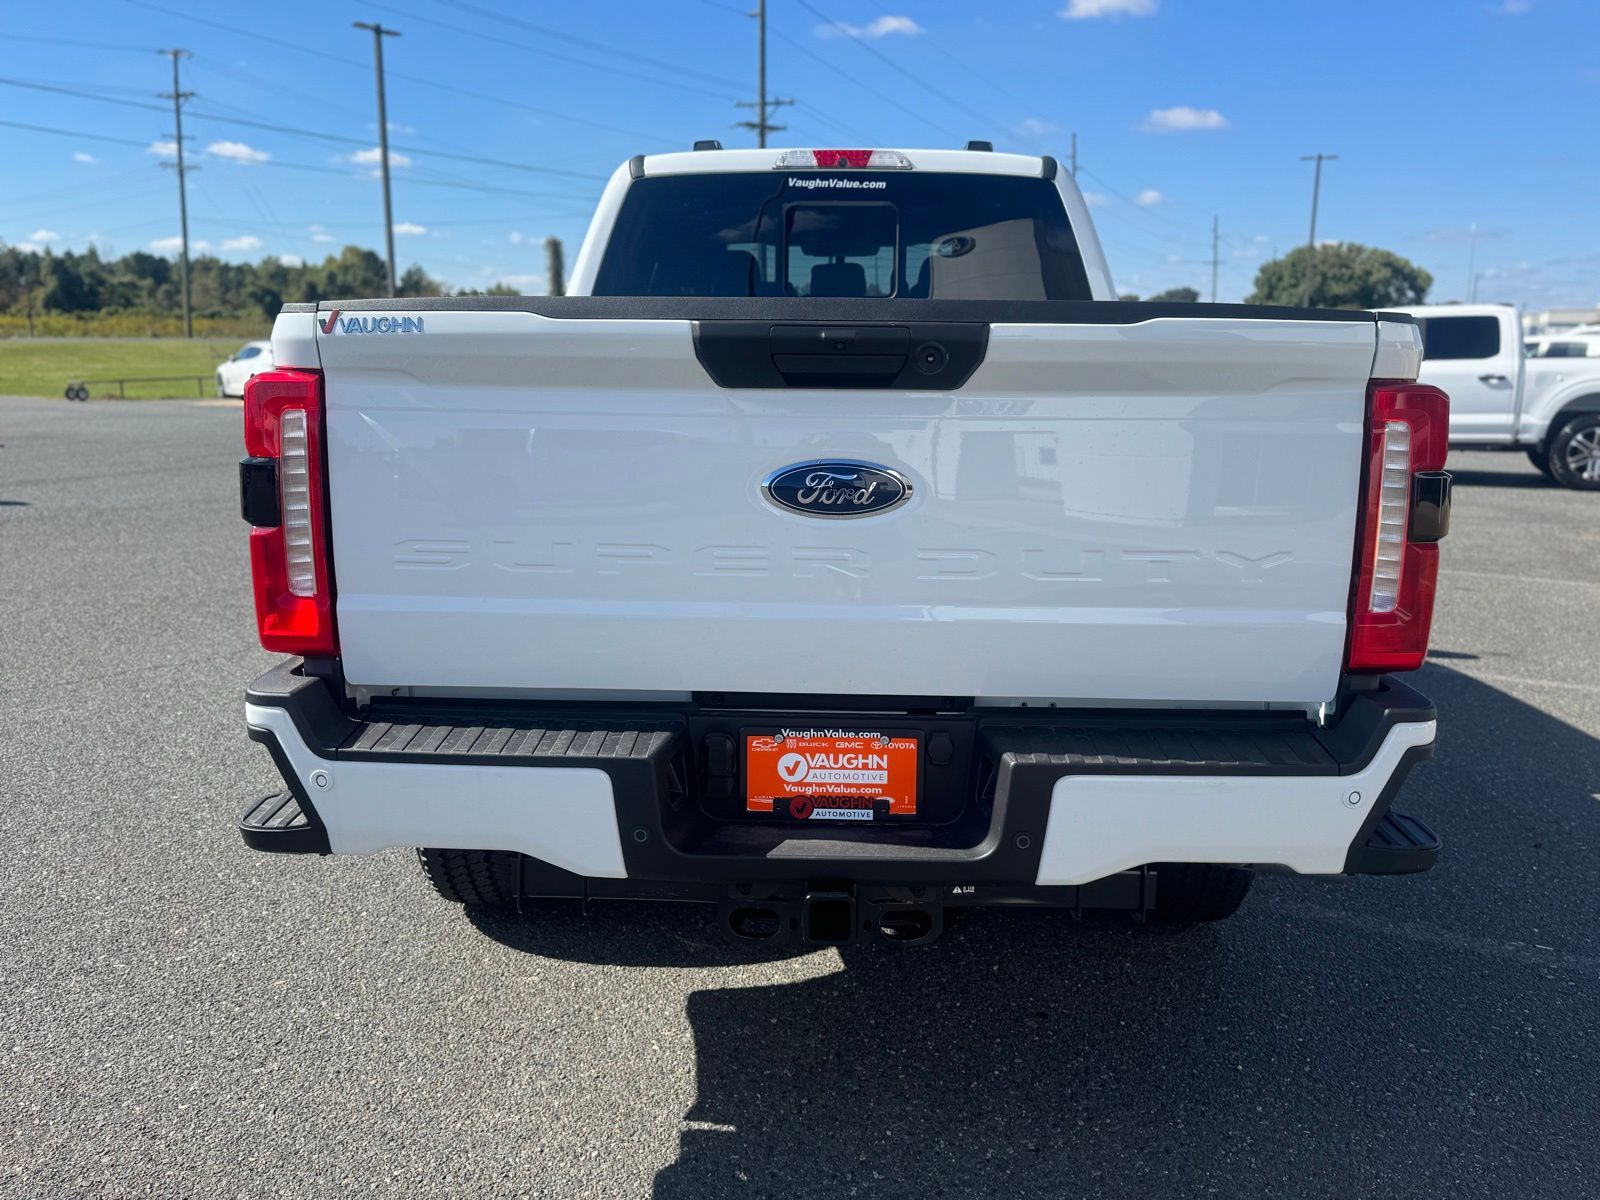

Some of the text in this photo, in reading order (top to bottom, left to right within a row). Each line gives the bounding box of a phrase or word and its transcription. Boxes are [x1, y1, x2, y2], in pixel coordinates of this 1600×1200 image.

[788, 178, 887, 189] VaughnValue.com
[337, 316, 424, 334] VAUGHN
[797, 472, 878, 504] Ford
[392, 538, 1296, 583] SUPER DUTY
[782, 728, 881, 740] VaughnValue.com
[835, 741, 864, 749] GMC
[805, 753, 888, 769] VAUGHN
[811, 772, 885, 781] AUTOMOTIVE
[784, 784, 882, 794] VaughnValue.com
[811, 795, 873, 808] VAUGHN
